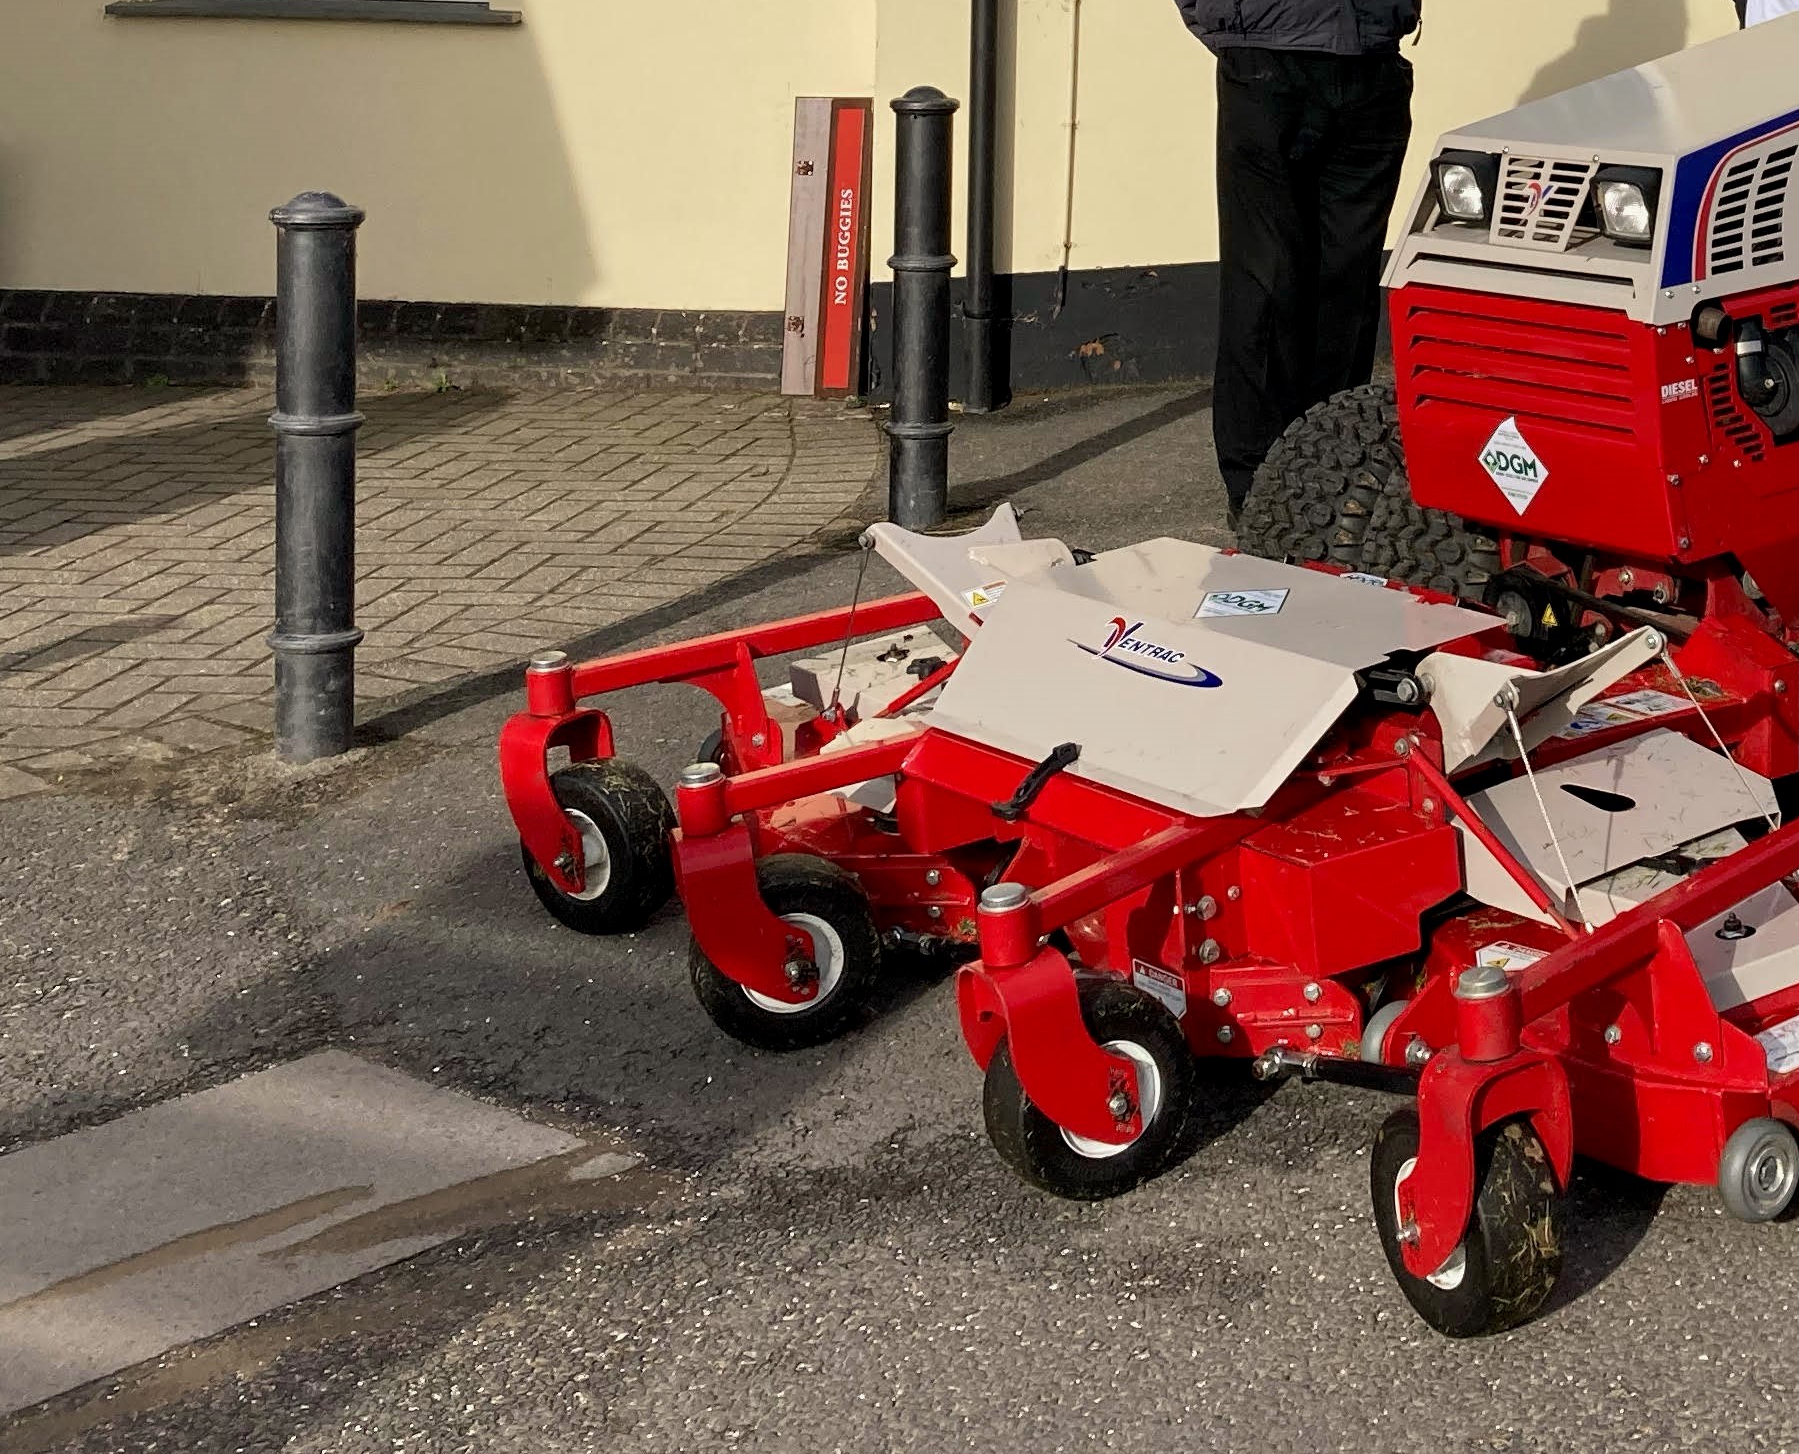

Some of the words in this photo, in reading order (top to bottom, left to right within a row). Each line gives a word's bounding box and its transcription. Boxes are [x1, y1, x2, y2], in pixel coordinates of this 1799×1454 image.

[835, 188, 853, 271] BUGGIES
[834, 276, 848, 305] NO
[1661, 379, 1698, 398] DIESEL
[1495, 450, 1538, 478] DGM
[1094, 616, 1185, 664] VENTRAC
